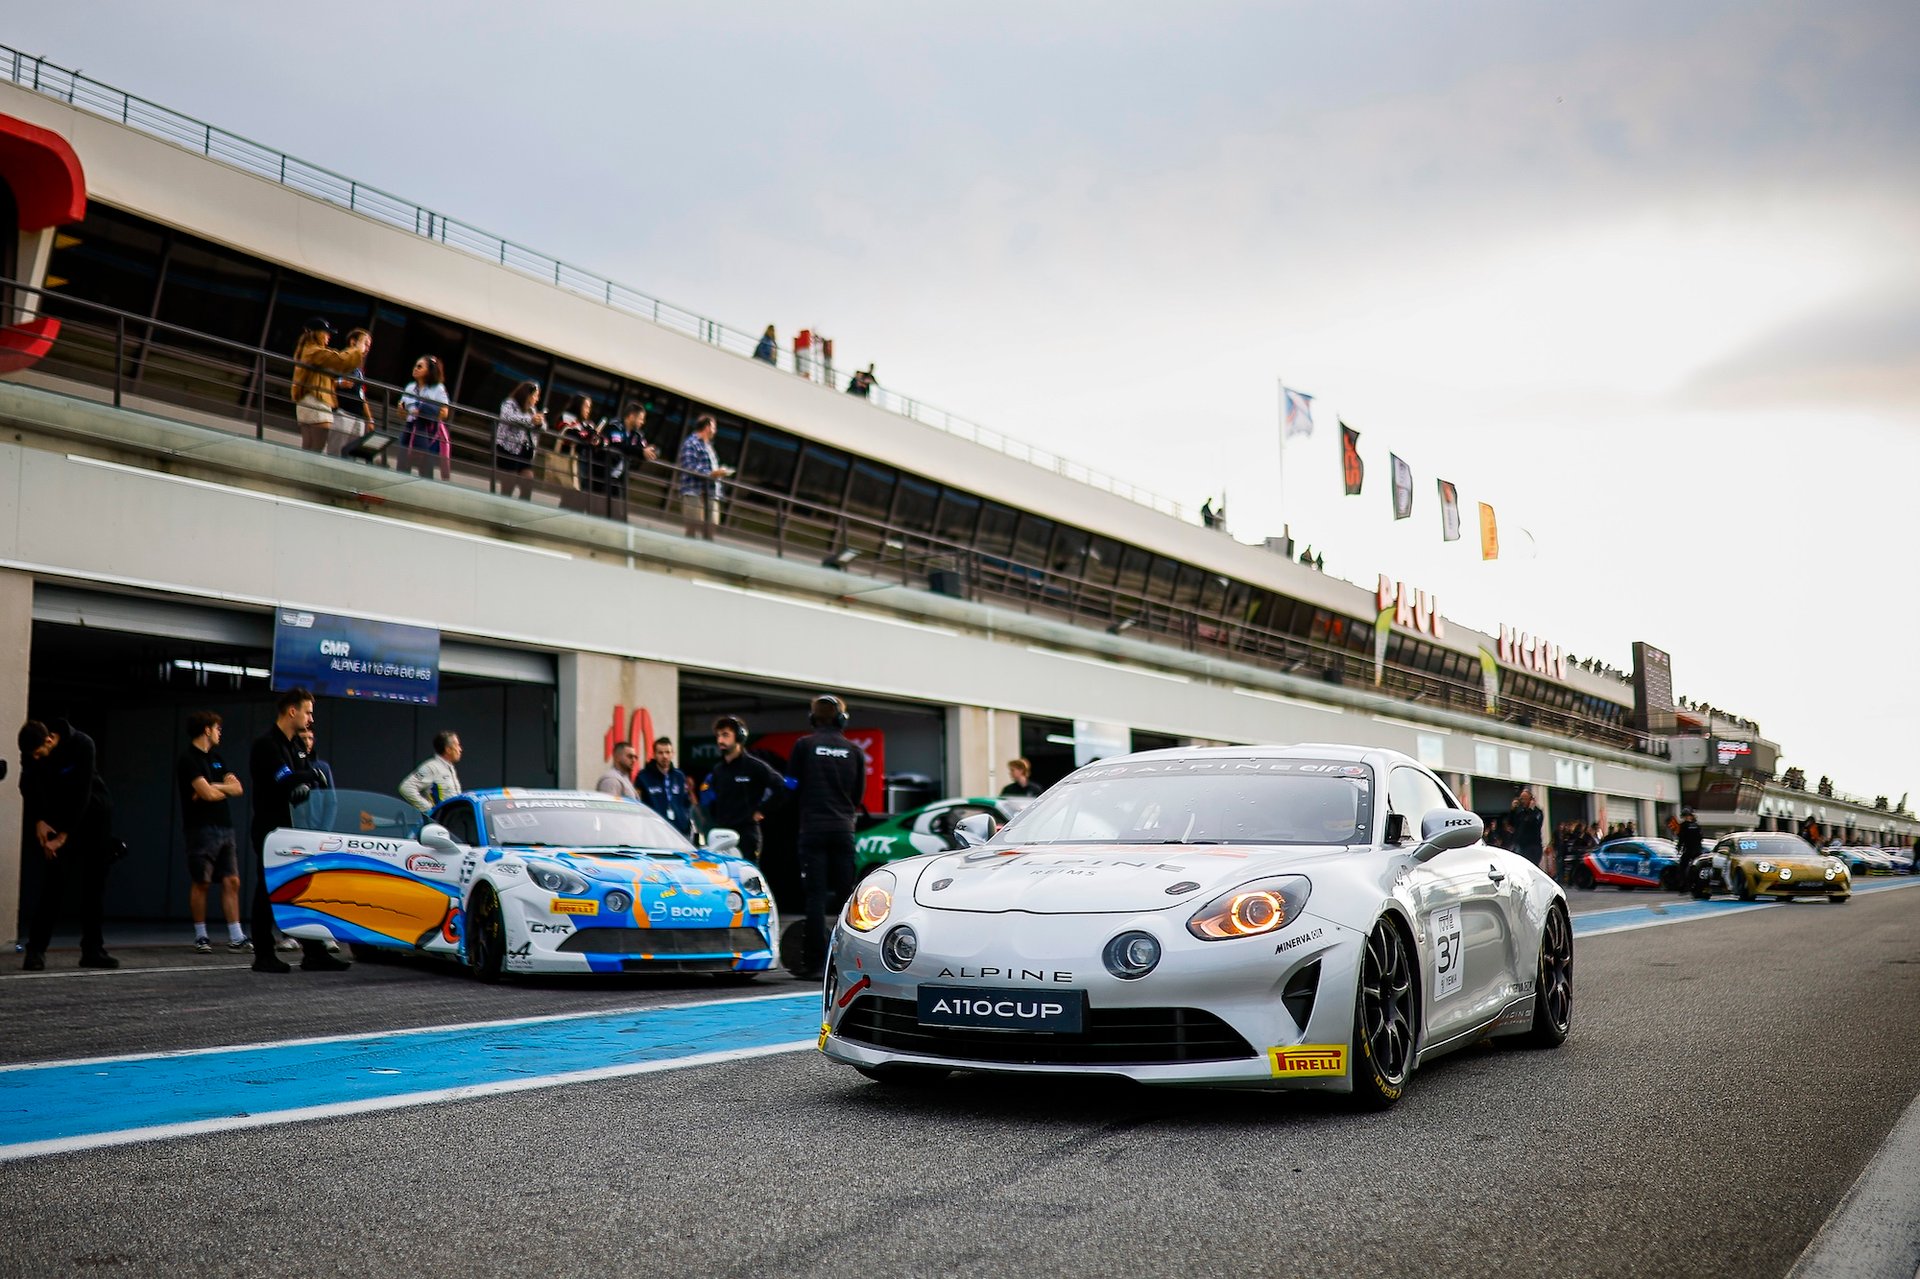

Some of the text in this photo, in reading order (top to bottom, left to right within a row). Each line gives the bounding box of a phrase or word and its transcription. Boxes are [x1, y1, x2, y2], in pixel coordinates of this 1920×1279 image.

[1376, 573, 1567, 681] PAUL RICARD
[320, 639, 350, 657] CMR
[815, 746, 850, 758] CMR
[515, 799, 586, 809] RACING
[1445, 819, 1472, 827] HRX
[348, 840, 403, 852] BONY
[856, 835, 898, 855] NTK
[671, 906, 712, 918] BONY
[530, 924, 572, 935] CMR
[1275, 933, 1312, 955] MINERVA
[1437, 931, 1460, 974] 37
[937, 967, 1073, 983] ALPINE
[931, 998, 1063, 1019] A110CUP
[1275, 1050, 1342, 1071] PIRELLI
